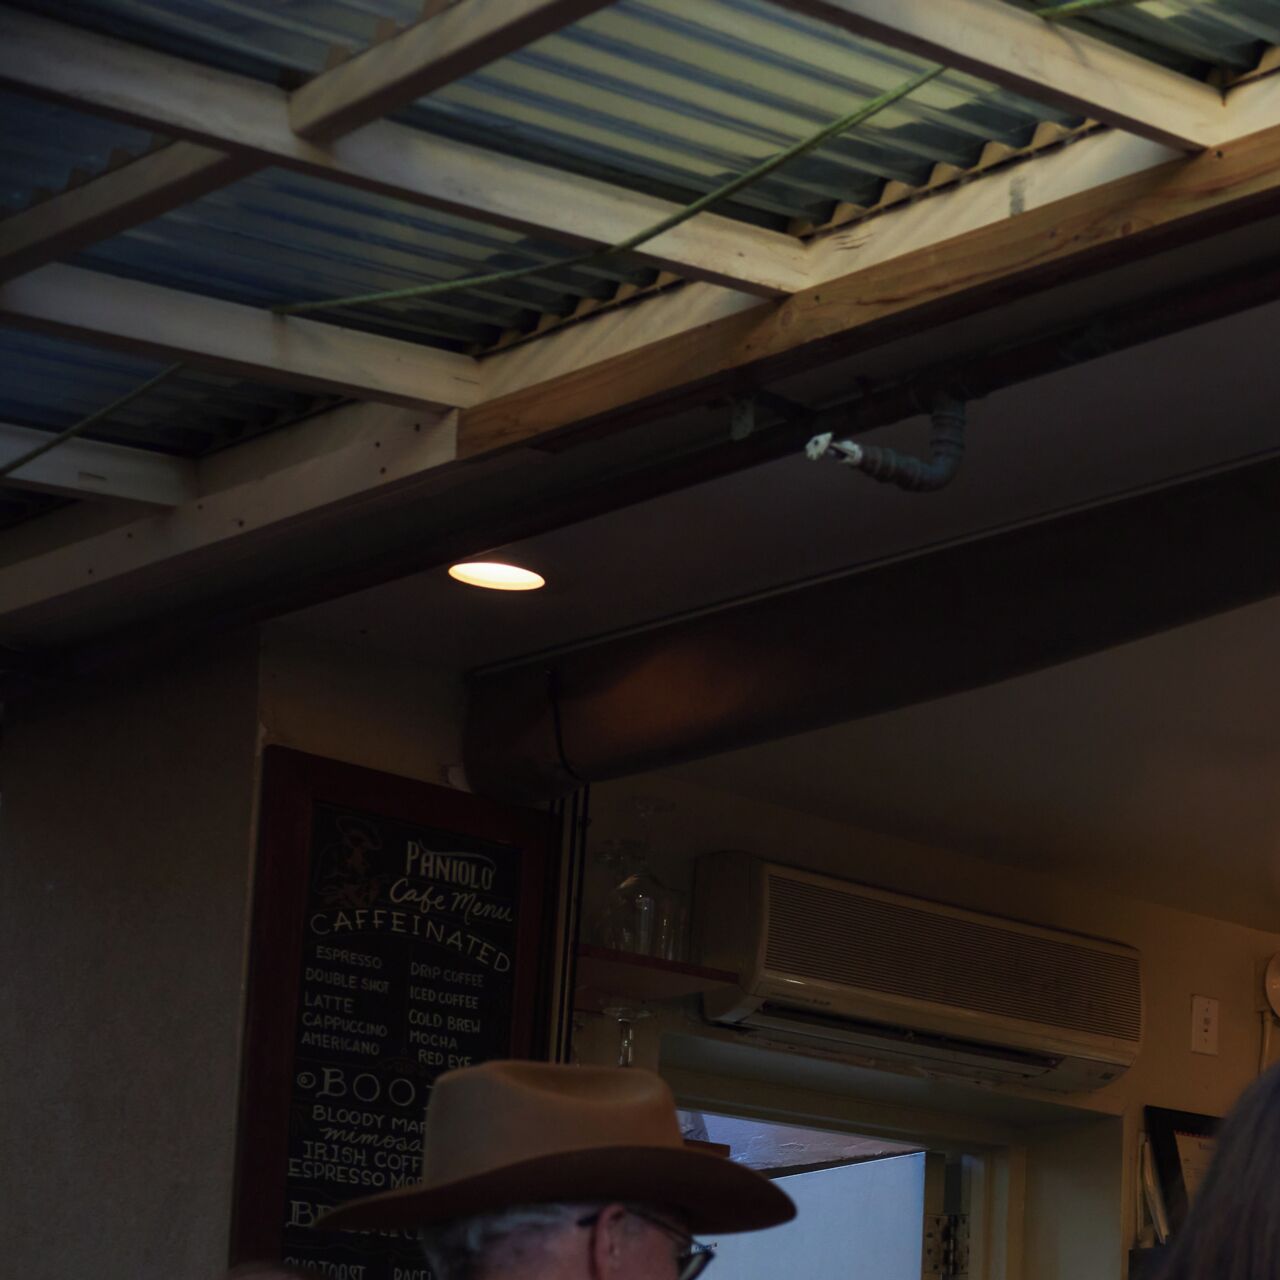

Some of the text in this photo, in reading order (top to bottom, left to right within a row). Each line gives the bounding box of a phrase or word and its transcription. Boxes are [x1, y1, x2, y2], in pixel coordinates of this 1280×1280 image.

[406, 838, 496, 891] PANIOLO
[390, 878, 514, 925] Cafe Menu
[310, 909, 512, 973] CAFFEINATED
[316, 945, 383, 969] ESPRESSO
[305, 967, 390, 994] DOUBLE SHOT
[410, 962, 485, 988] DRIP COFFEE
[304, 991, 355, 1013] LATTE
[409, 984, 480, 1009] ICED COFFEE
[302, 1011, 388, 1038] CAPPUCCINO
[408, 1008, 481, 1033] COLD BREW
[301, 1032, 381, 1056] AMERICANO
[409, 1031, 458, 1050] MOCHA
[418, 1049, 444, 1065] RED
[315, 1067, 434, 1111] BOO
[312, 1104, 386, 1130] BLOODY
[319, 1126, 424, 1153] mimosa
[303, 1140, 369, 1168] IRISH
[288, 1158, 386, 1187] ESPRESSO
